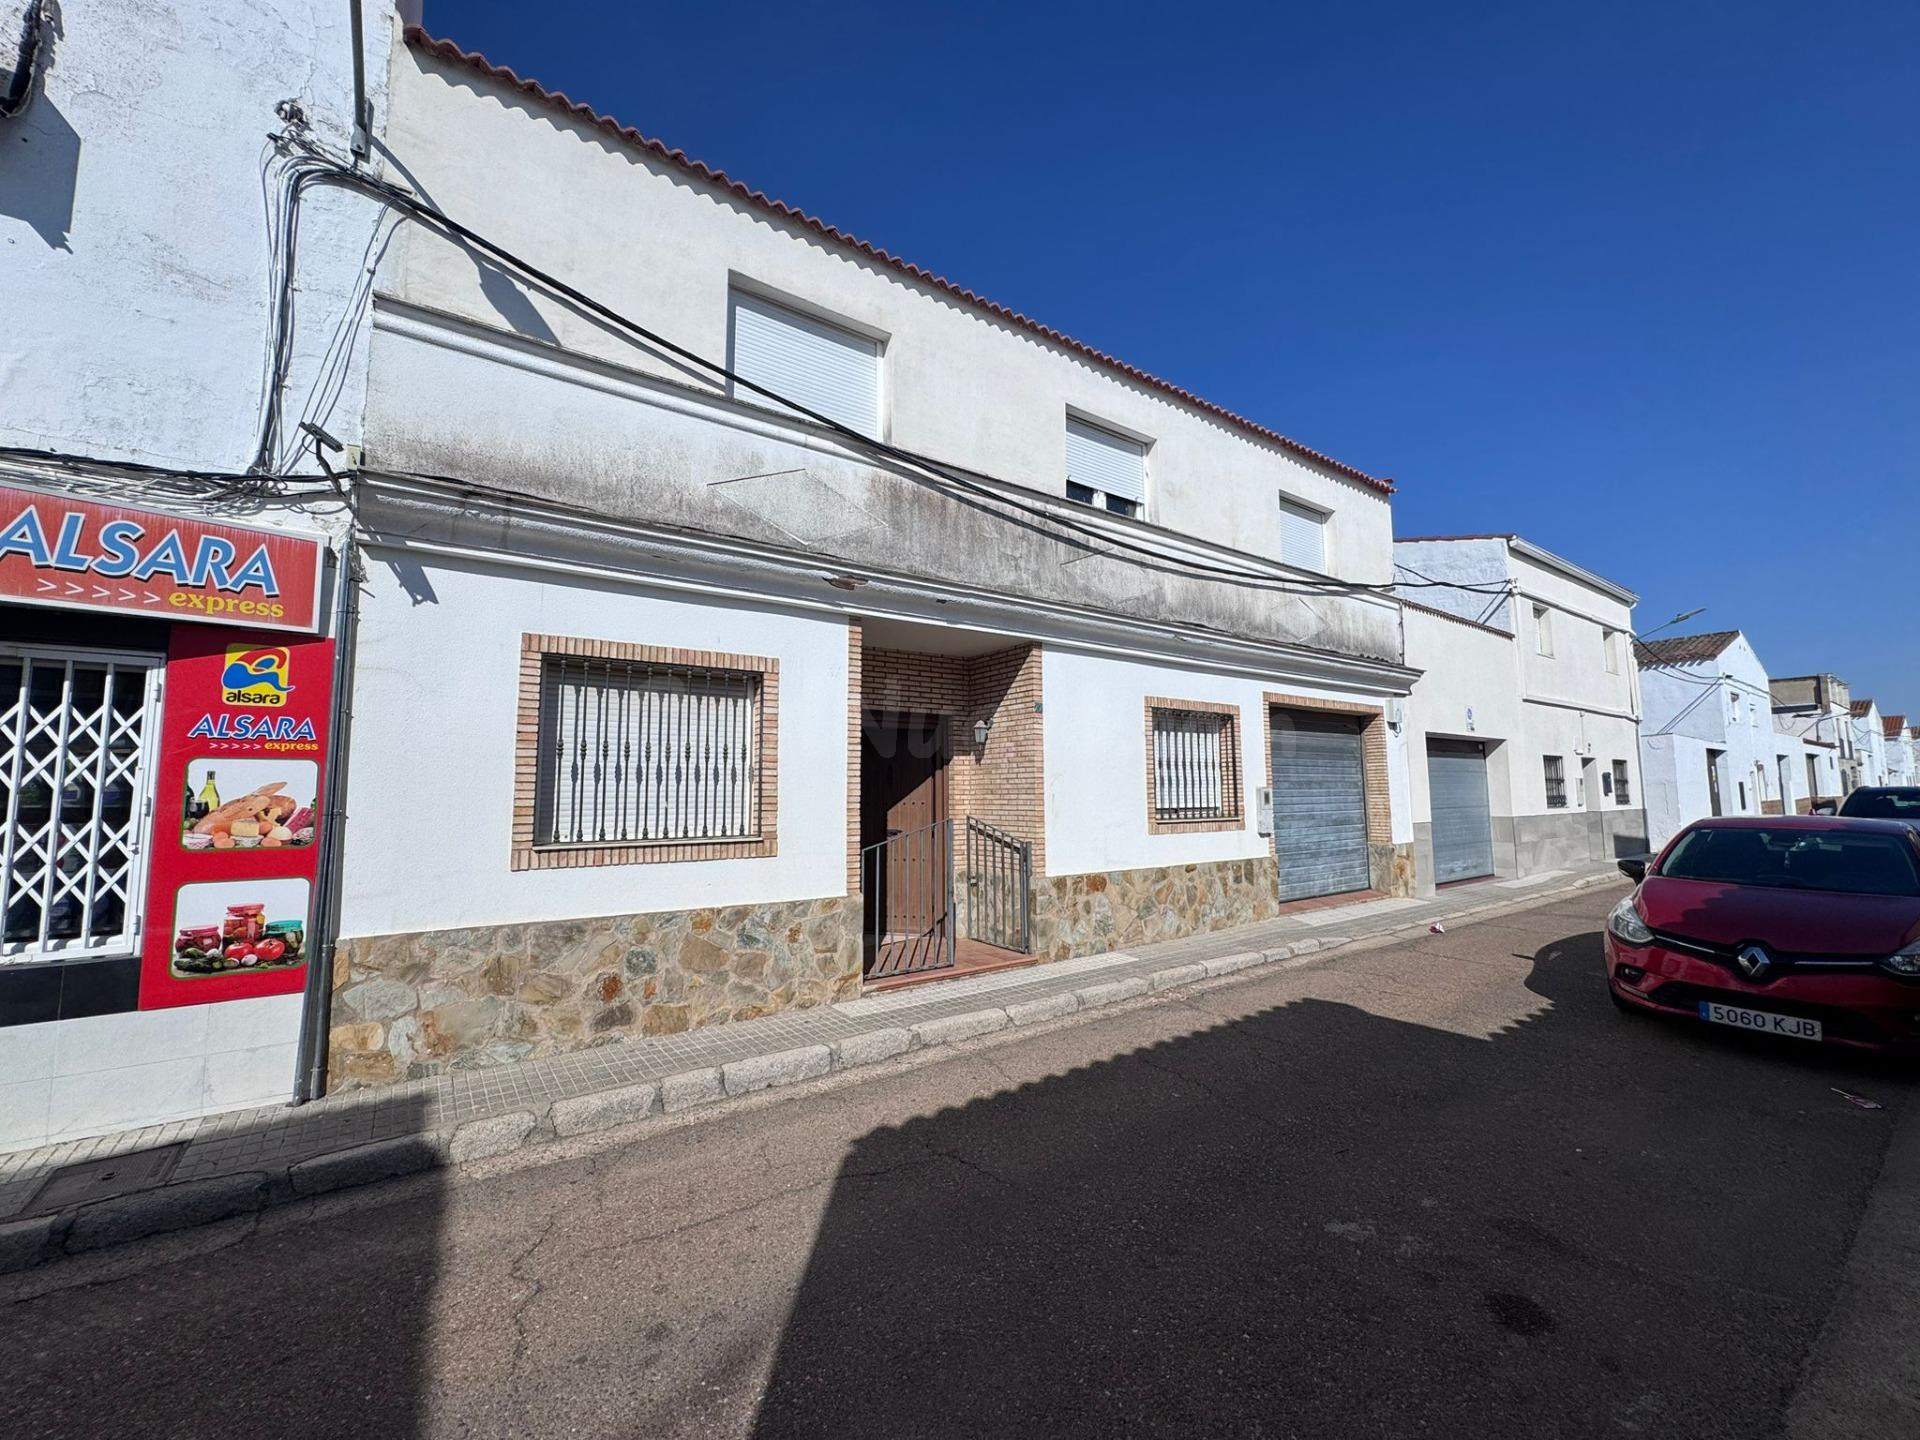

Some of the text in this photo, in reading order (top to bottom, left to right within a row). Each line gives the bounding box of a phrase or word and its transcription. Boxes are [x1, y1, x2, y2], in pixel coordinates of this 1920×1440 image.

[0, 505, 280, 597] ALSARA
[168, 590, 285, 618] express
[226, 690, 281, 705] alsara
[187, 713, 317, 741] ALSARA
[264, 742, 319, 752] express
[1713, 1006, 1816, 1037] 5060 KJB
